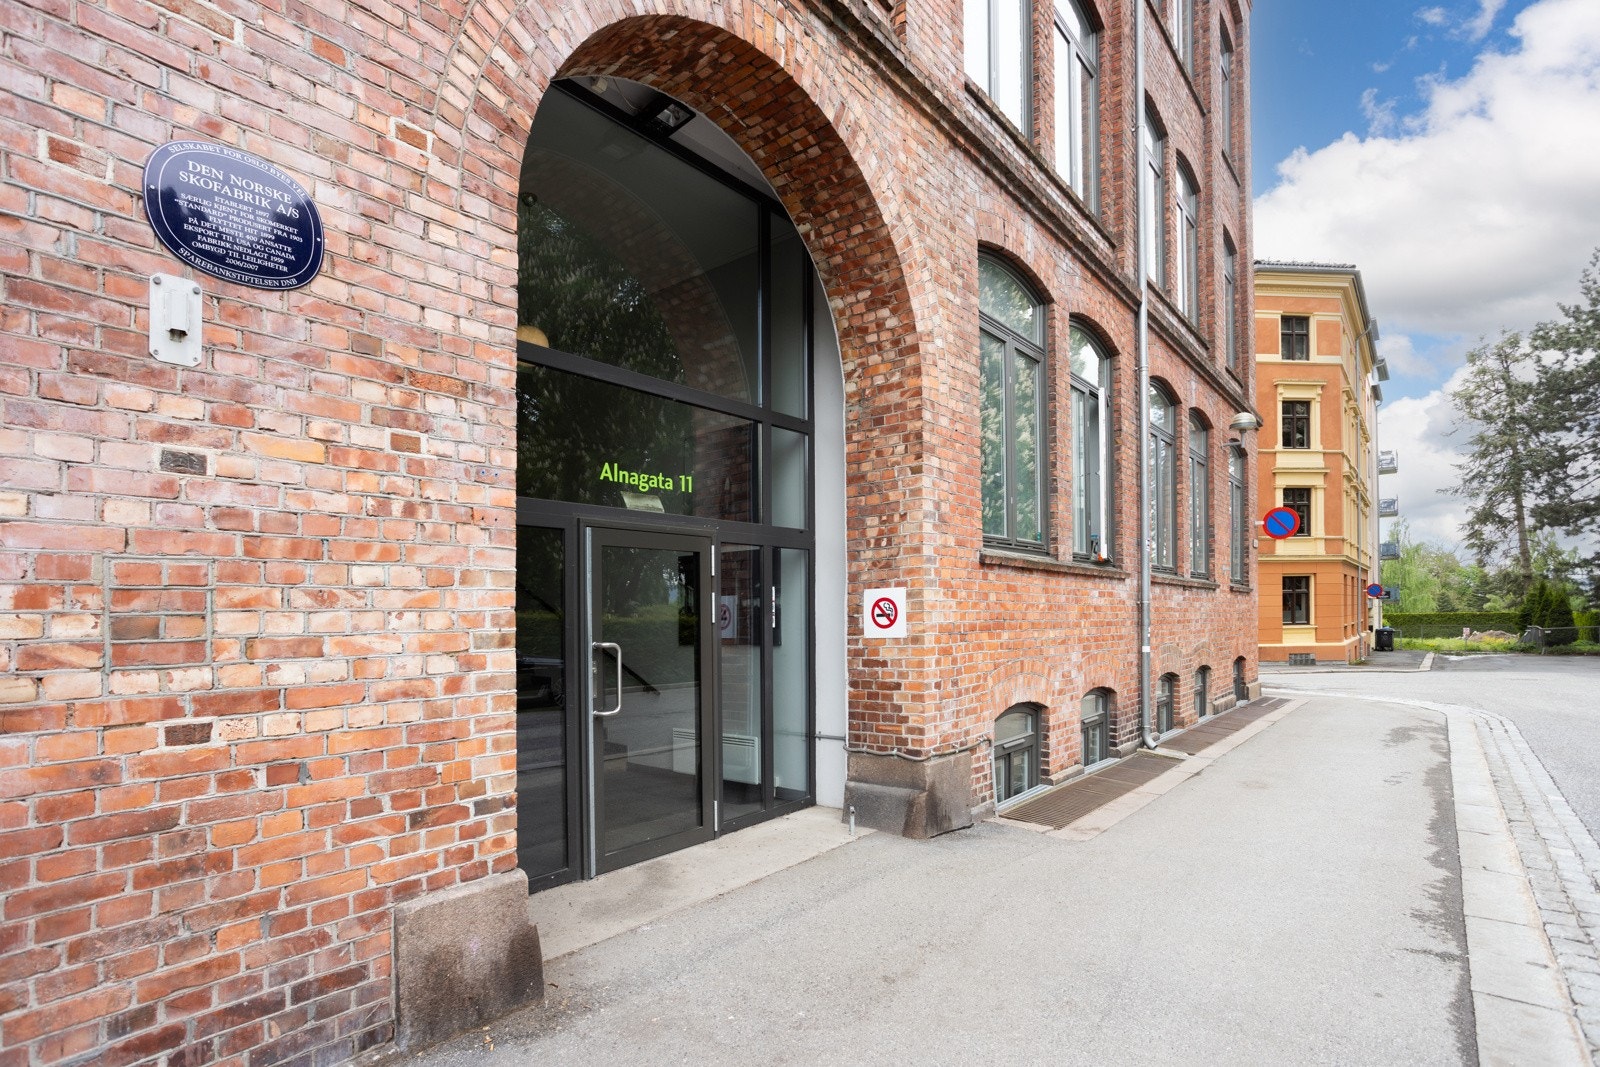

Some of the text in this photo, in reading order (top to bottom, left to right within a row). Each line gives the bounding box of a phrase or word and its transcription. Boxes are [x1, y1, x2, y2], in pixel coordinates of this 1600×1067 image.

[168, 143, 222, 154] SELSKABET
[223, 148, 242, 160] FOR
[244, 156, 268, 170] OSLO
[292, 184, 306, 198] VEL
[188, 160, 292, 204] DEN NORSKE
[178, 170, 300, 218] SKOFABRIK A/S
[214, 196, 254, 212] ETABLERT
[181, 193, 298, 234] SÆRLIG KJENT FOR SKOMERKET
[209, 216, 242, 230] FLYTTET
[245, 227, 258, 235] HIT
[229, 214, 272, 232] PRODUSERT
[274, 228, 288, 238] FRA
[184, 224, 220, 238] EKSPORT
[222, 234, 234, 242] TIL
[236, 238, 251, 248] USA
[266, 247, 296, 260] CANADA
[198, 235, 232, 248] FABRIKK
[234, 245, 268, 260] NEDLAGT
[201, 220, 216, 229] DET
[219, 226, 244, 238] MESTE
[259, 238, 292, 252] ANSATTE
[178, 248, 298, 286] SPAREBANKSTIFTELSEN DNB
[192, 241, 288, 272] OMBYGD TIL LEILIGHETER
[226, 258, 258, 270] 2006/2007
[600, 462, 692, 492] Alnagata 11
